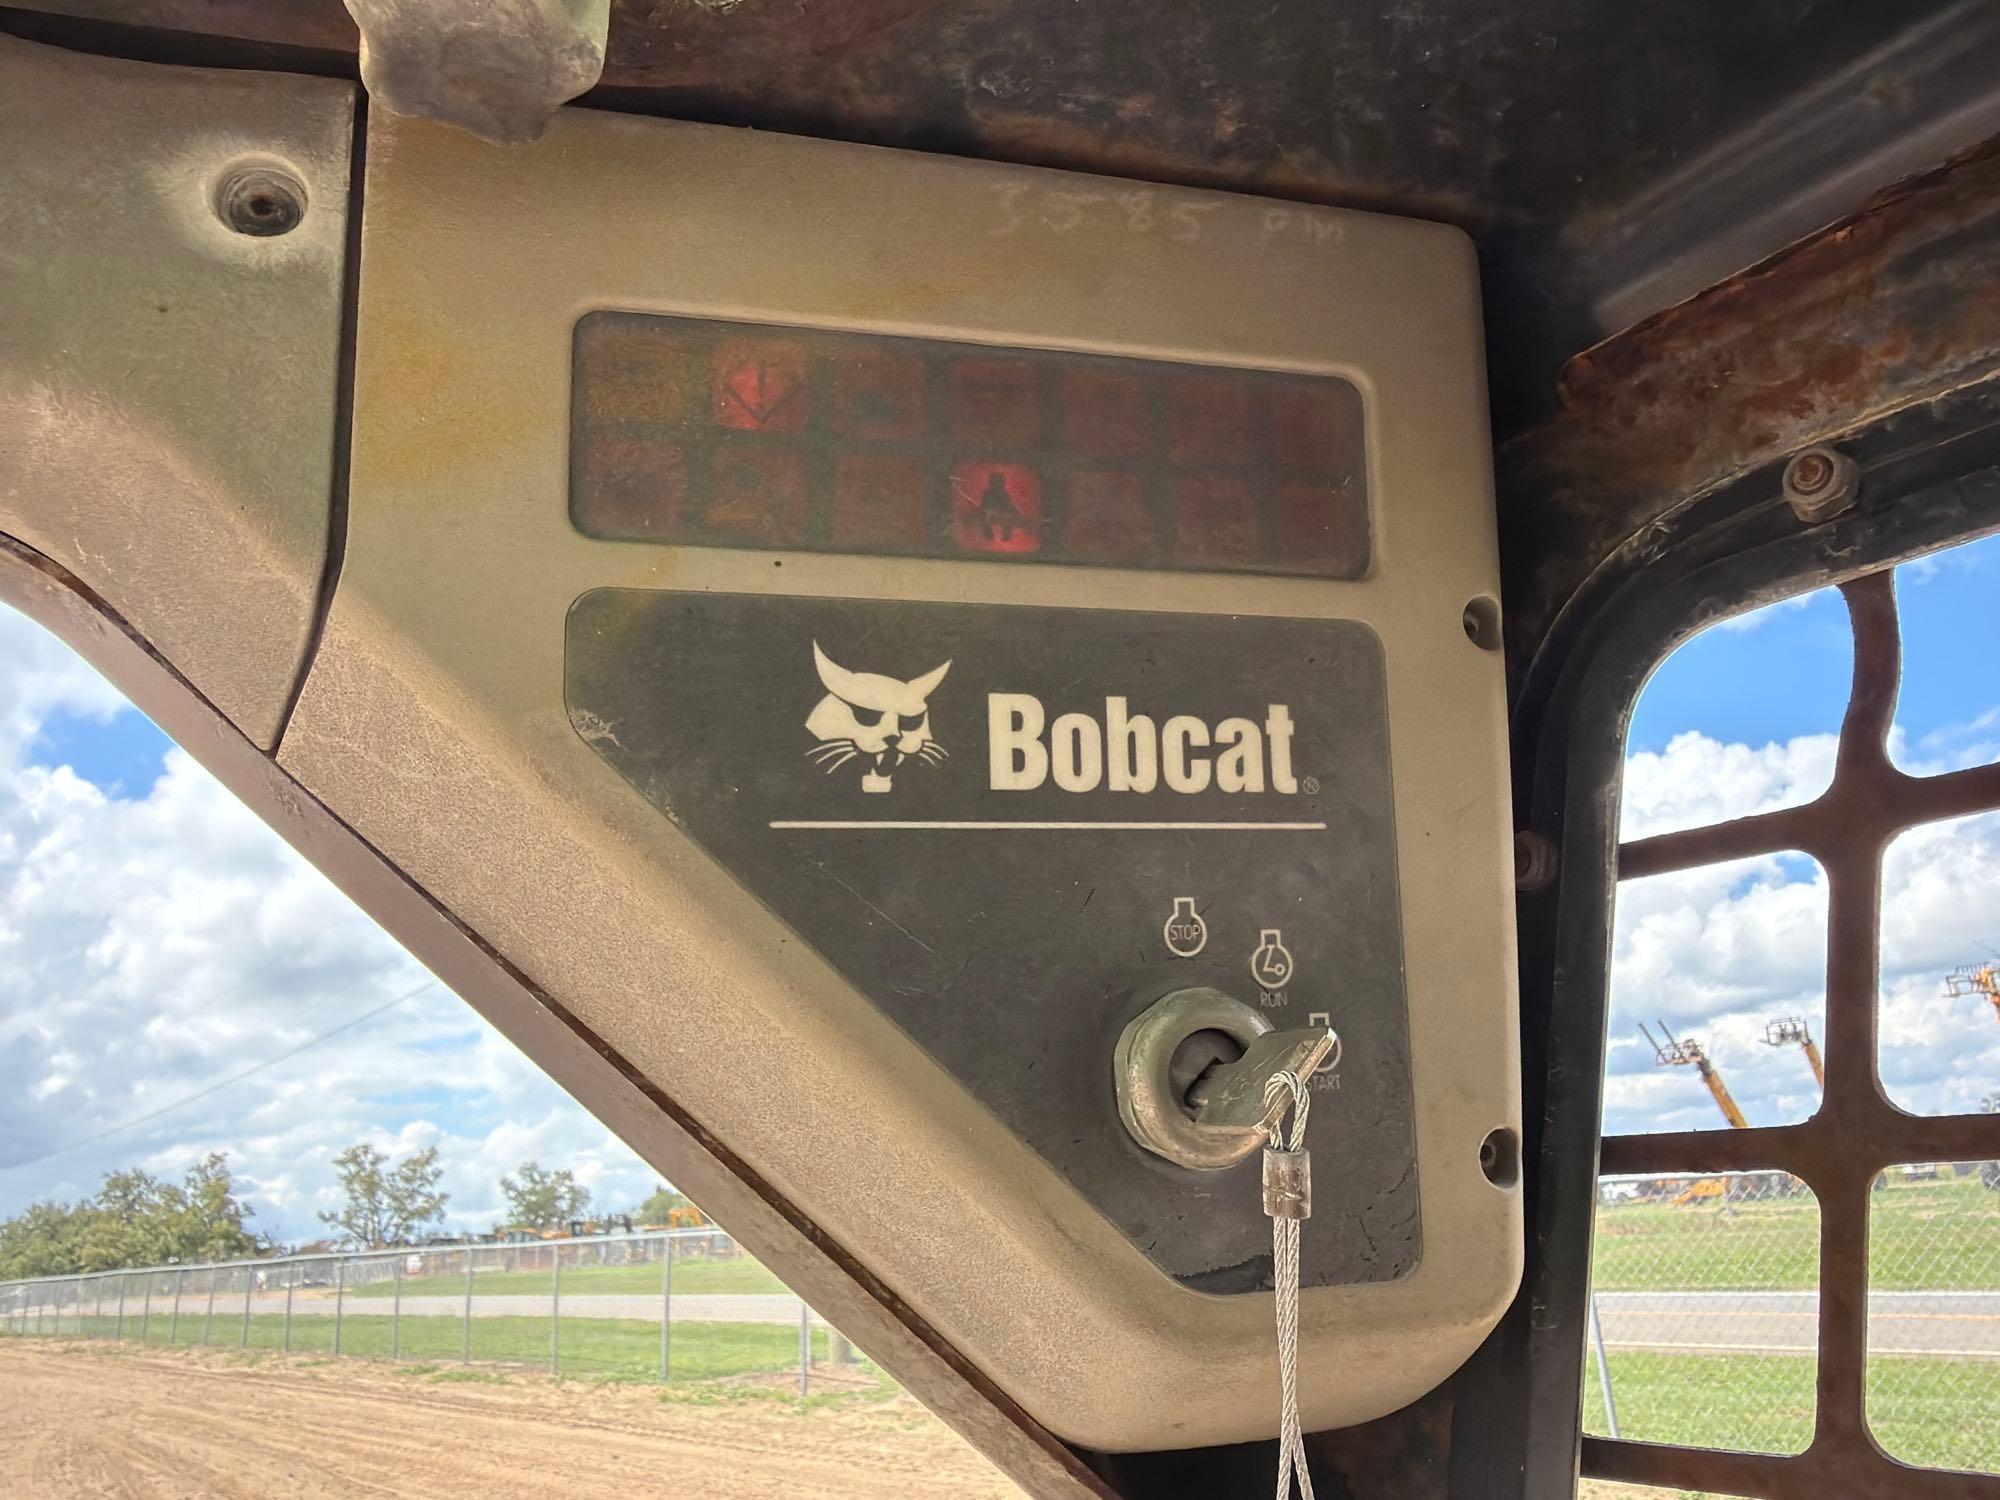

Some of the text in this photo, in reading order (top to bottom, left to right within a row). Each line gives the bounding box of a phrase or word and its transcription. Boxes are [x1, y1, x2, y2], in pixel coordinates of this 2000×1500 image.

[988, 693, 1298, 794] Bobcat
[1169, 924, 1201, 941] STOP
[1260, 992, 1288, 1007] RUN
